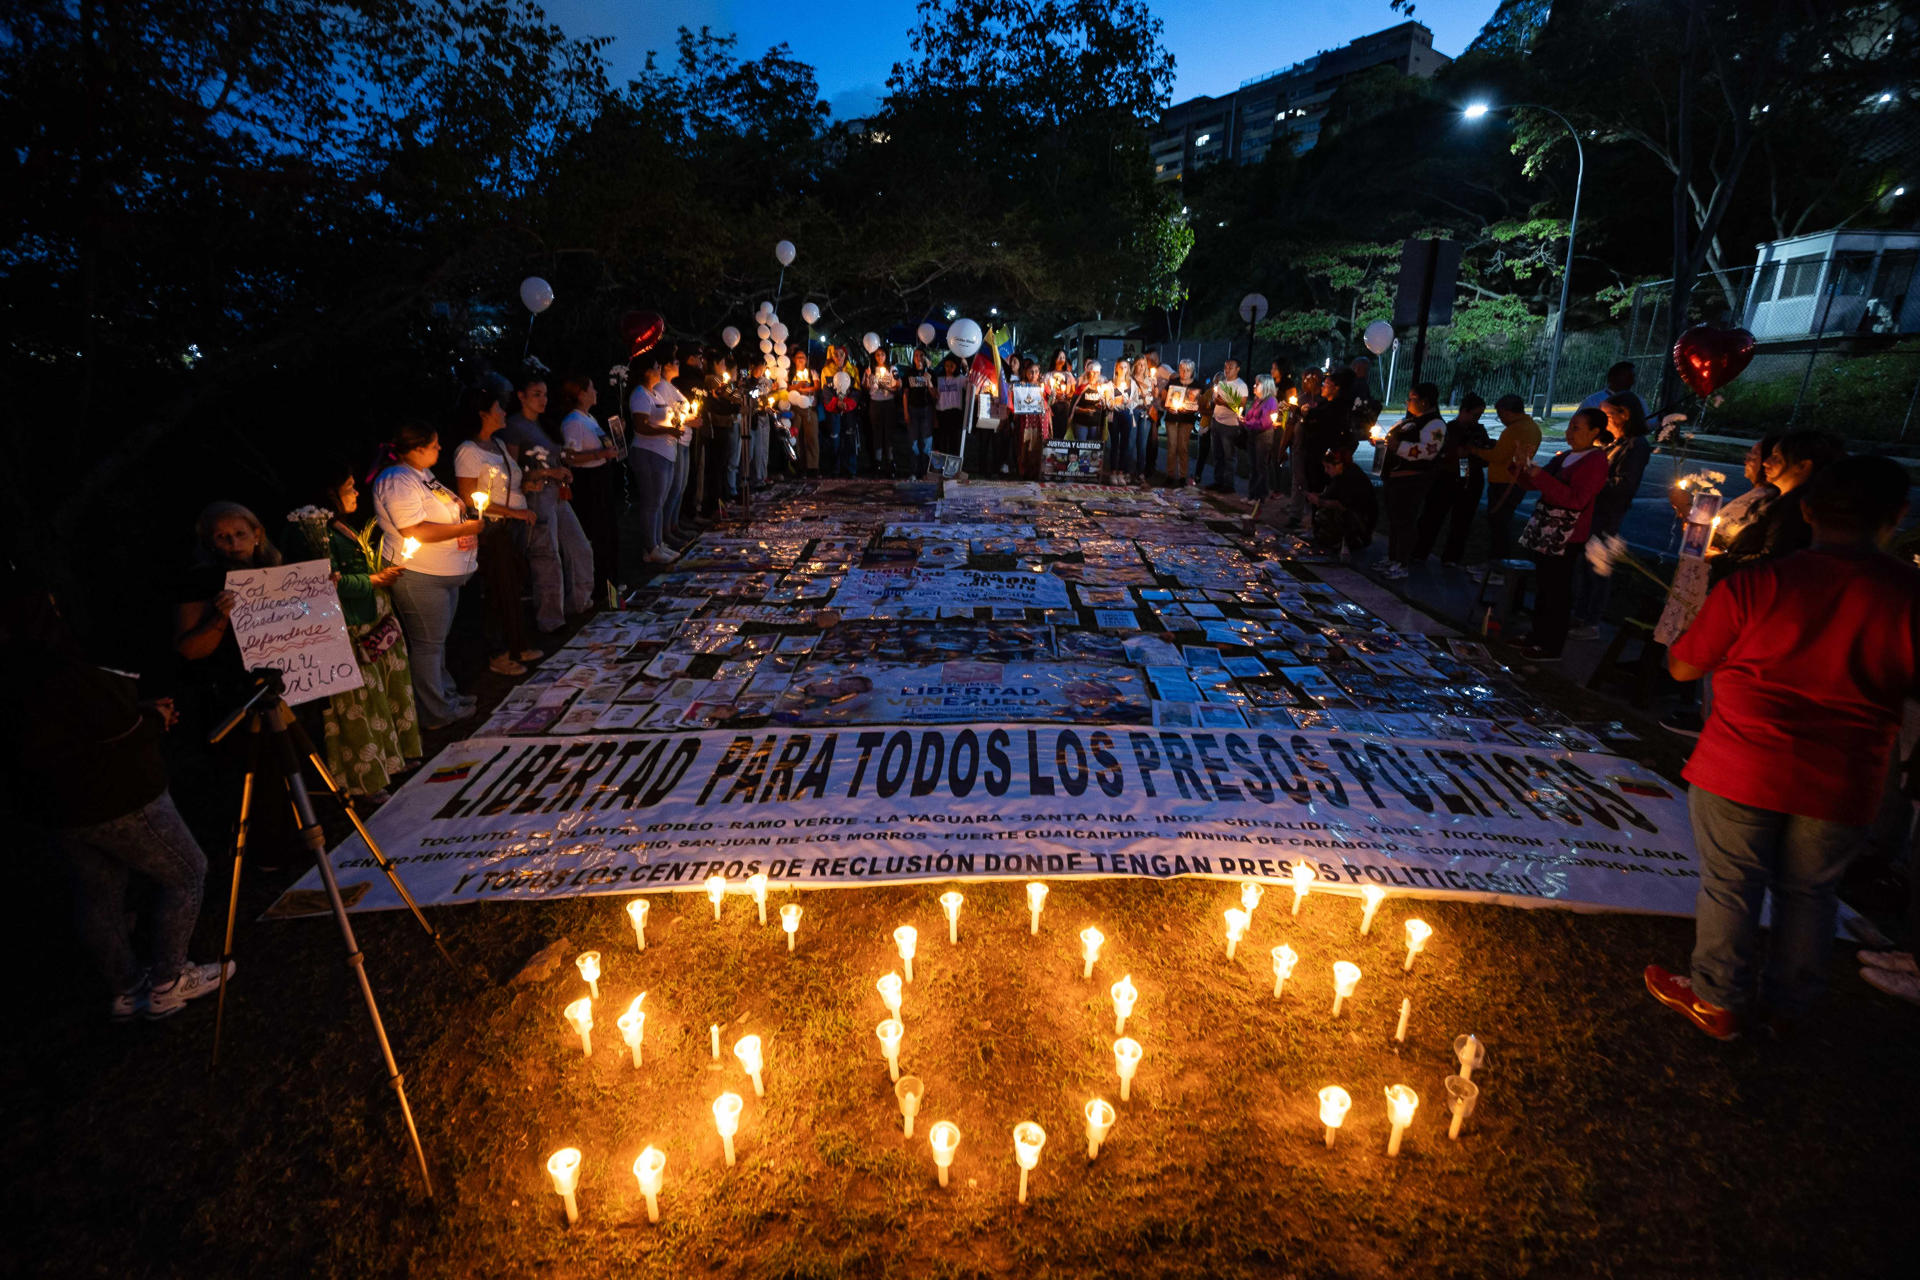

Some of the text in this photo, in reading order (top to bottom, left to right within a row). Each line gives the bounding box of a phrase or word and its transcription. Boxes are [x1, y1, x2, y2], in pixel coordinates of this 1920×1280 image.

[888, 696, 1052, 706] VENEZUELA
[901, 686, 1041, 696] LIBERTAD
[433, 728, 1659, 834] LIBERTAD PARA TODOS LOS PRESOS POLITICOS
[338, 854, 409, 870] CENRO
[612, 839, 671, 852] JUIO,
[678, 838, 718, 849] SAN
[721, 837, 771, 847] JUAN
[775, 836, 800, 845] DE
[805, 833, 841, 843] LOS
[847, 832, 927, 842] MORROS
[944, 830, 1019, 841] FUERTE
[1024, 829, 1161, 841] GUAICAIPURO
[1177, 831, 1253, 844] MINIMA
[1257, 835, 1284, 846] DE
[1289, 837, 1400, 852] CARABOBO
[420, 831, 513, 848] TOCUYITO
[555, 826, 631, 841] PLANTA
[647, 822, 714, 833] RODEO
[730, 819, 787, 830] RAMO
[794, 816, 858, 828] VERDE
[875, 814, 899, 824] LA
[907, 814, 1003, 824] YAGUARA
[1020, 813, 1088, 823] SANTA
[1097, 813, 1137, 823] ANA
[1559, 838, 1626, 855] FENIX
[1629, 846, 1689, 862] LARA
[452, 873, 479, 895] Y
[476, 869, 568, 893] TODOS
[569, 865, 628, 887] LOS
[630, 859, 762, 882] CENTROS
[767, 858, 807, 878] DE
[811, 849, 975, 877] RECLUSIÓN
[985, 852, 1083, 873] DONDE
[1090, 852, 1213, 876] TENGAN
